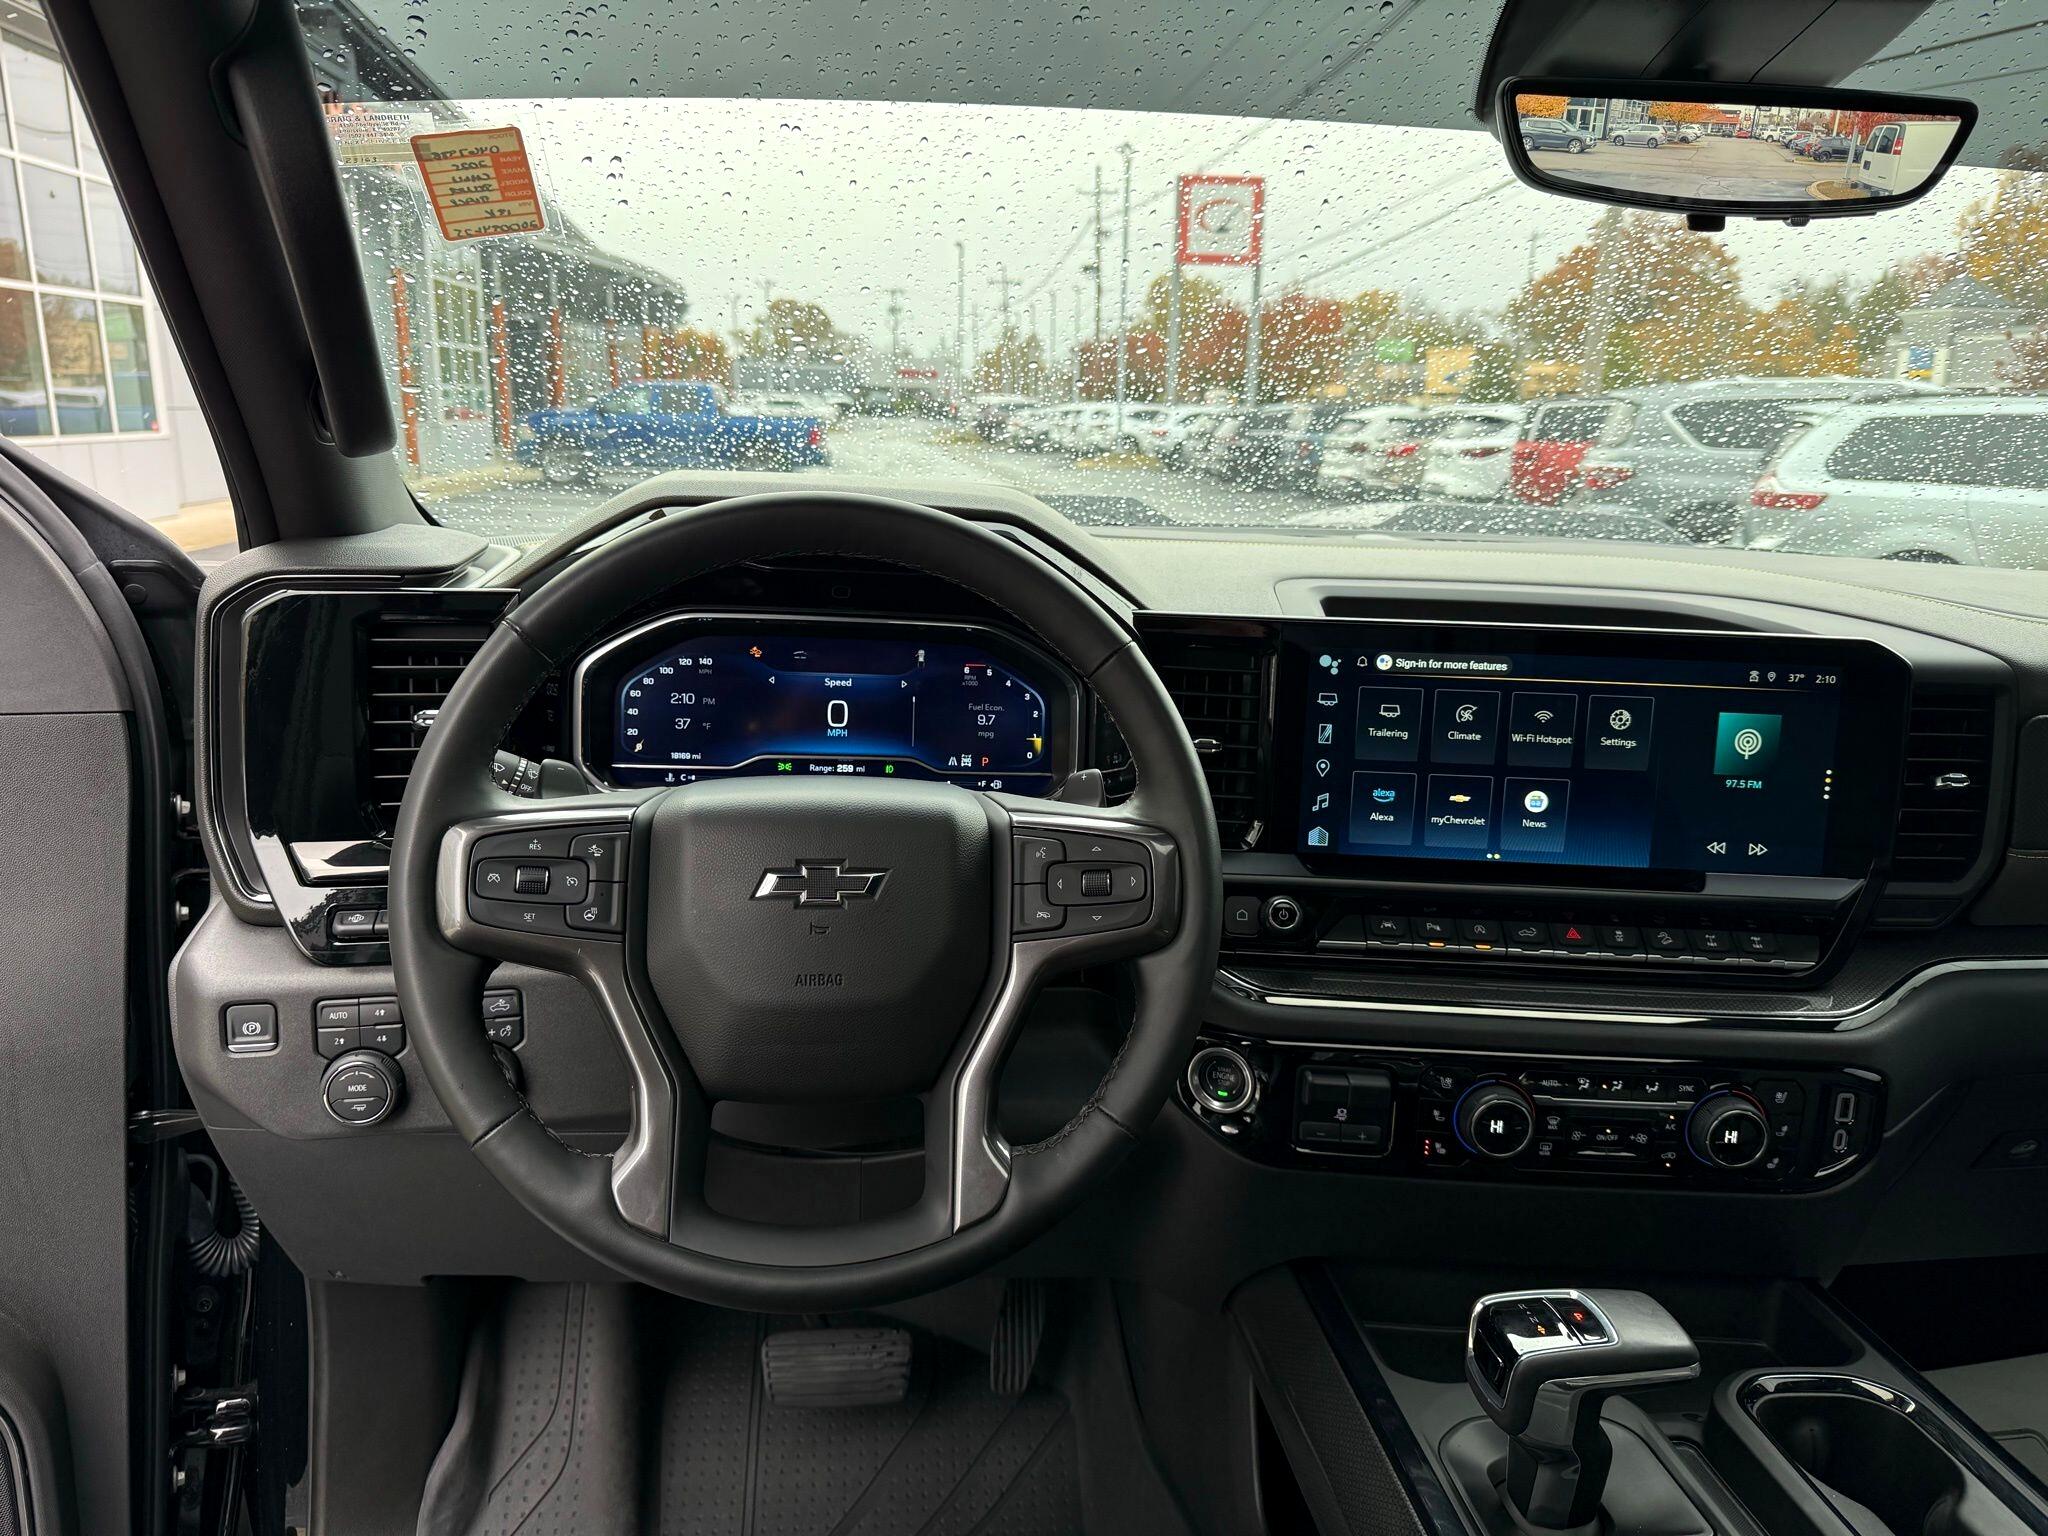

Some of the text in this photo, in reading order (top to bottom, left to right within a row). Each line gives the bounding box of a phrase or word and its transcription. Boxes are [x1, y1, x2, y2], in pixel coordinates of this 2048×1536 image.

[1395, 658, 1508, 671] Sign-in for more features
[963, 666, 970, 674] 6
[643, 677, 655, 685] 80
[824, 678, 852, 688] Speed
[1815, 675, 1837, 684] 2:10
[670, 693, 695, 705] 2:10
[1024, 693, 1030, 701] 3
[968, 703, 984, 711] Fuel
[826, 699, 849, 728] 0
[1033, 710, 1039, 718] 2
[675, 718, 691, 729] 37
[977, 714, 996, 726] 9.7
[827, 729, 848, 737] MPH
[978, 731, 995, 739] mpg
[1368, 727, 1408, 740] Trailering
[1447, 731, 1482, 741] Climate
[1511, 733, 1573, 746] Wi-Fi Hotspot
[1600, 736, 1637, 748] Settings
[691, 752, 701, 760] mi
[981, 757, 989, 766] P
[809, 764, 865, 773] Range: 259 mi
[520, 784, 532, 792] OFF
[981, 780, 987, 788] F
[1725, 779, 1762, 789] 97.5 FM
[1372, 788, 1395, 797] alexa
[1370, 812, 1394, 822] Alexa
[1431, 815, 1486, 827] myChevrolet
[1522, 818, 1547, 829] News
[523, 912, 536, 920] SET
[795, 973, 843, 987] AIRBAG
[329, 1012, 348, 1020] AUTO
[348, 1084, 367, 1092] MODE
[1678, 1084, 1695, 1093] SYNC
[1490, 1120, 1504, 1134] HI
[1665, 1123, 1677, 1131] A/C
[1596, 1133, 1619, 1142] ON/OFF
[1724, 1130, 1739, 1144] HI
